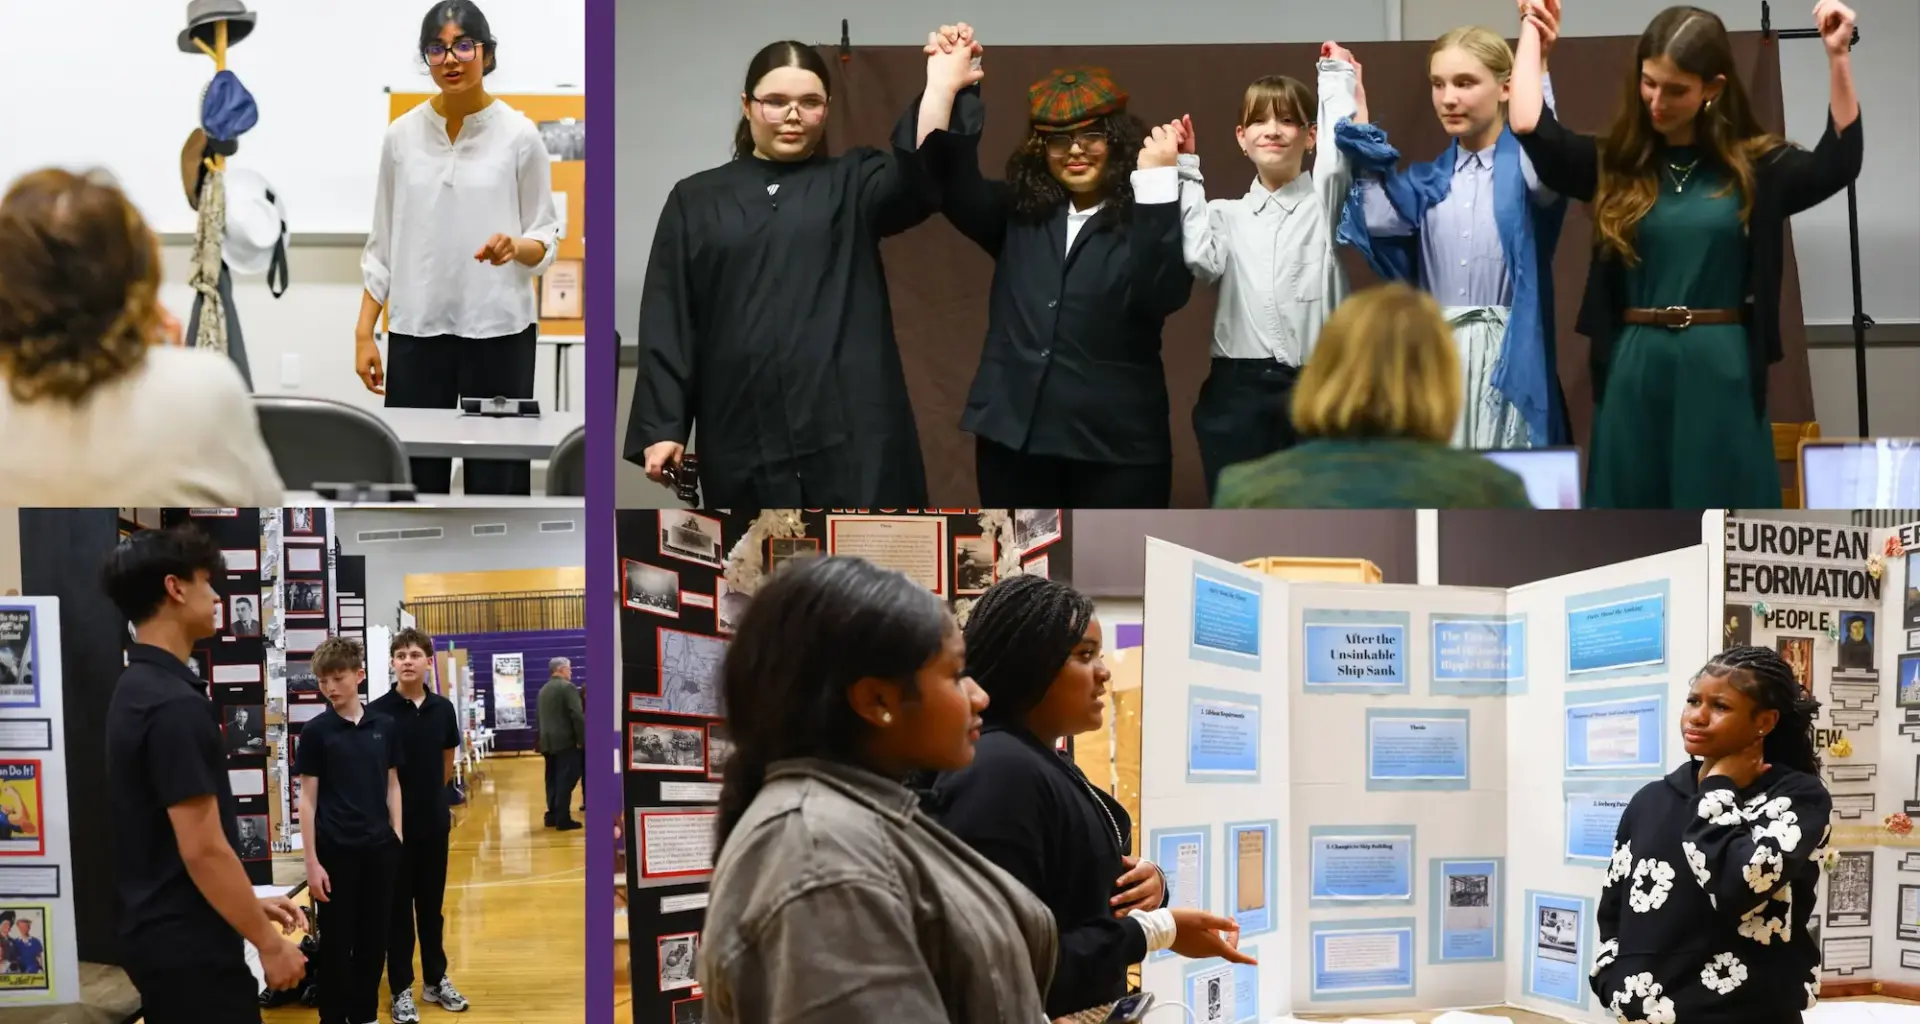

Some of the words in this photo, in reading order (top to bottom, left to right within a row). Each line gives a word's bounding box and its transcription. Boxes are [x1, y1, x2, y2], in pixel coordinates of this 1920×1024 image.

[1726, 521, 1869, 560] EUROPEAN
[1764, 609, 1830, 632] PEOPLE
[1345, 633, 1375, 645] After
[1376, 633, 1396, 645] the
[1330, 649, 1396, 660] Unsinkable
[1337, 664, 1365, 679] Ship
[1366, 664, 1396, 676] Sank
[9, 765, 22, 776] Do
